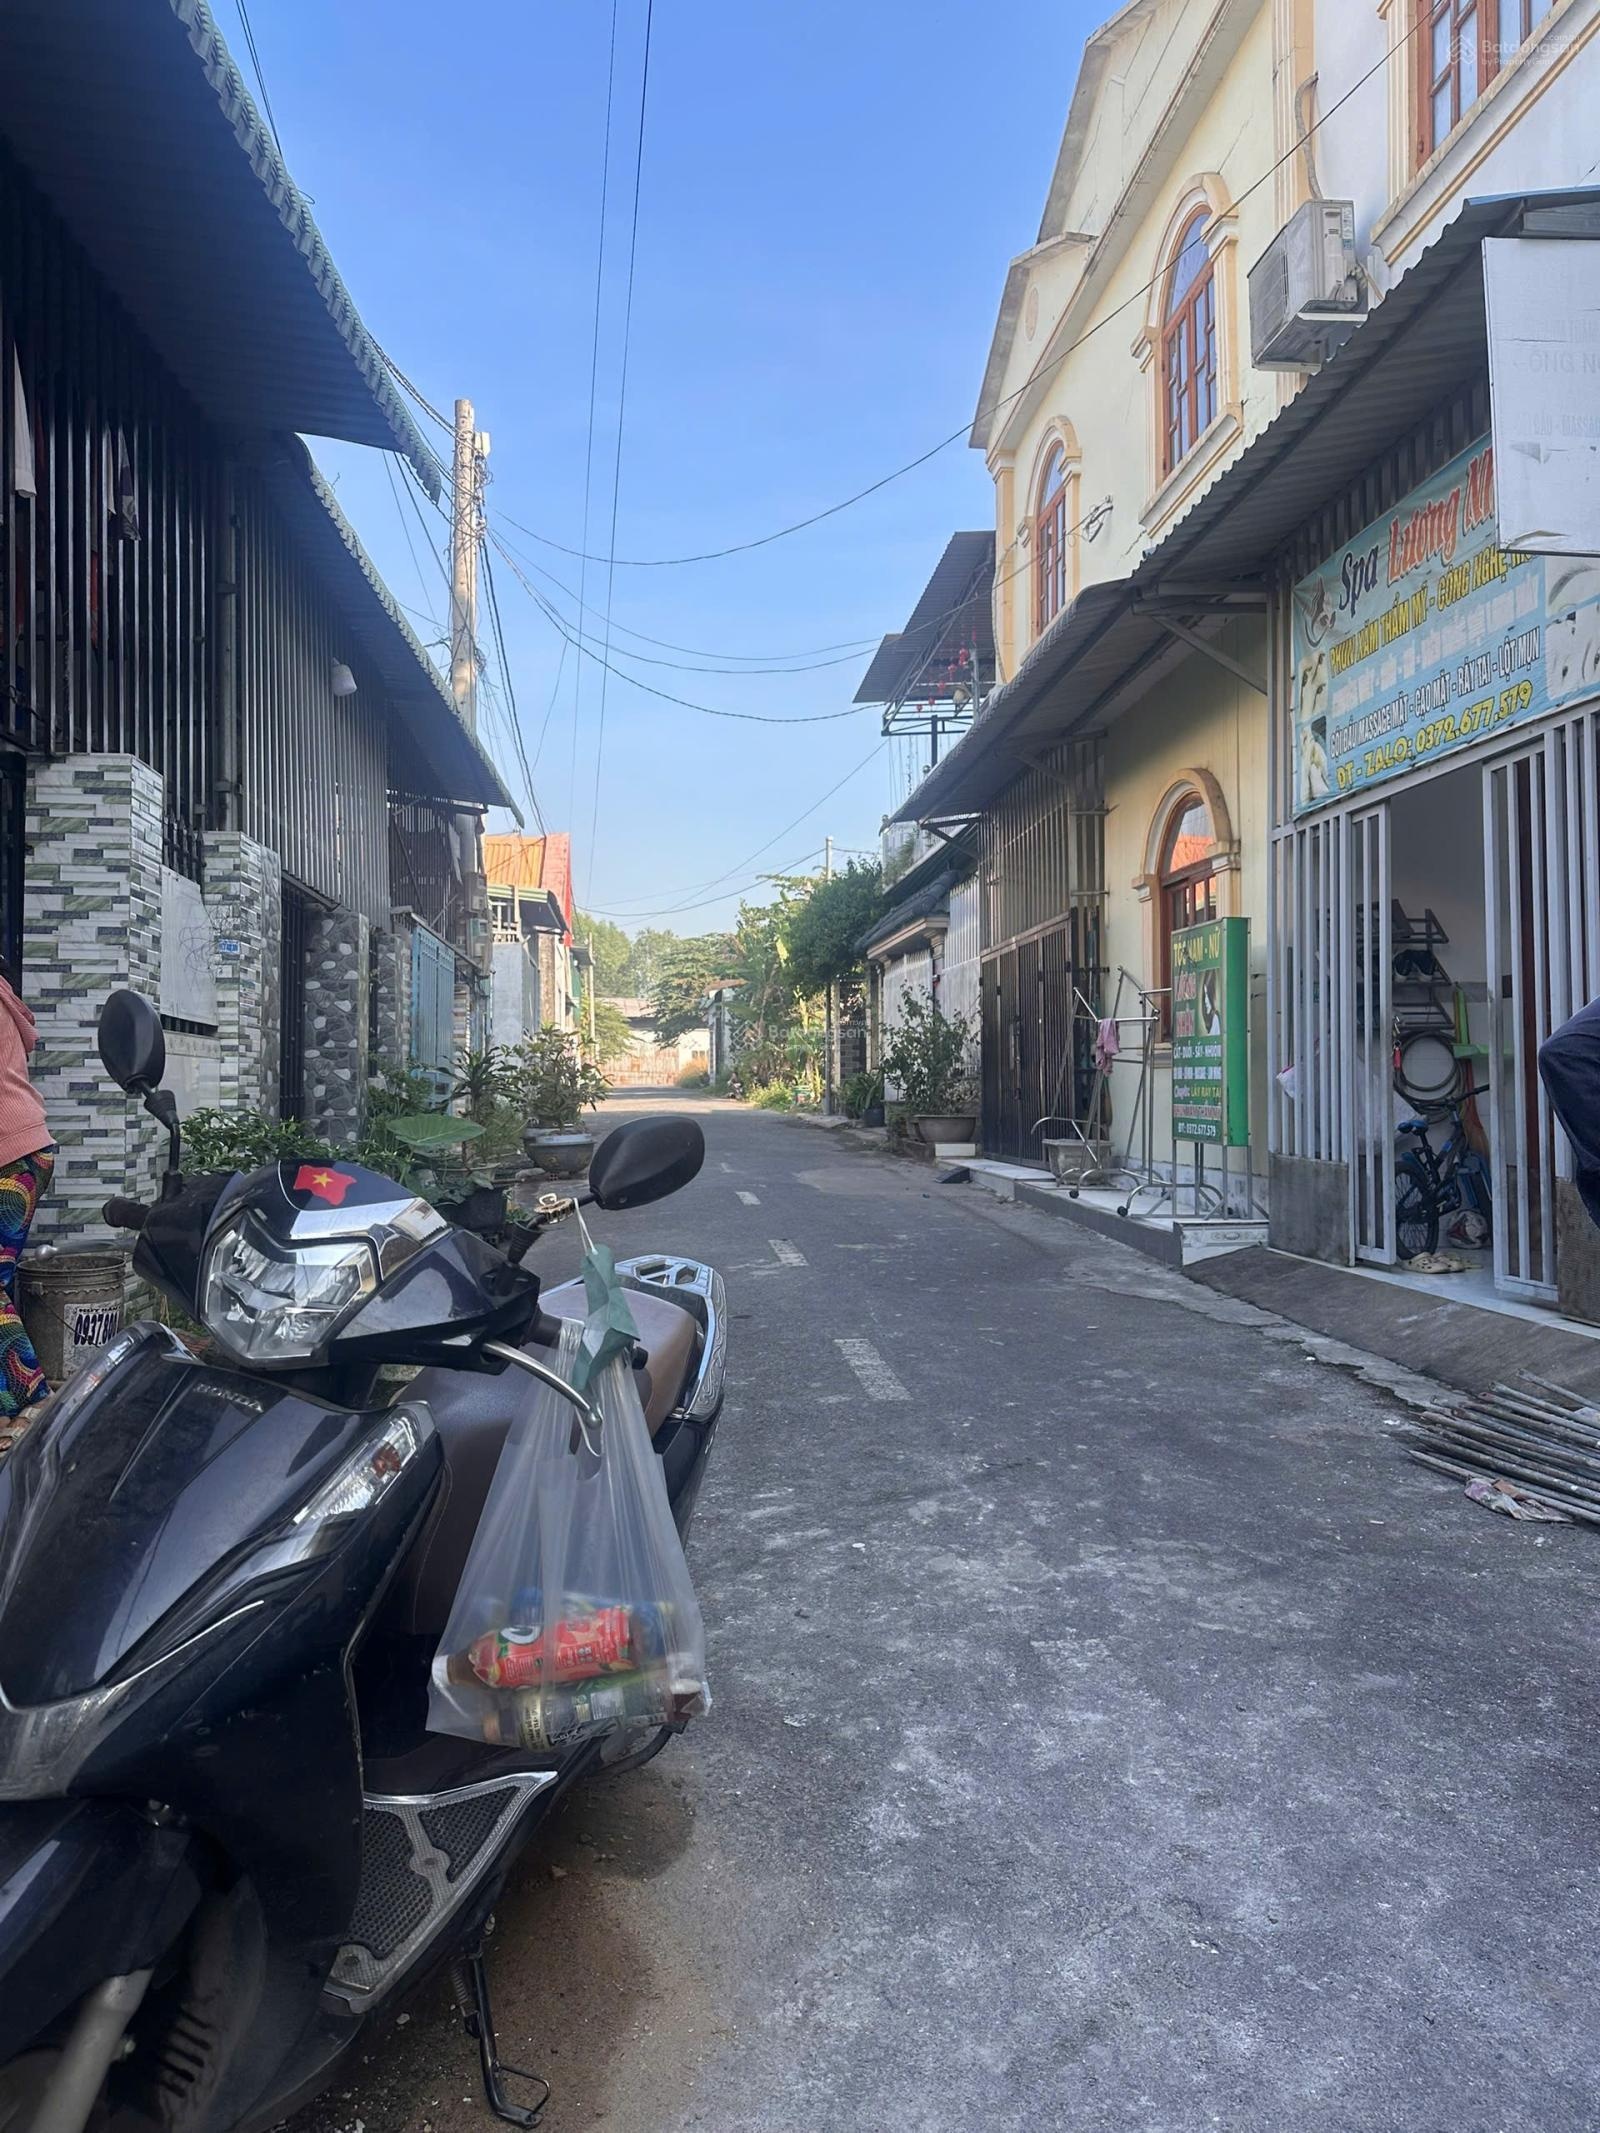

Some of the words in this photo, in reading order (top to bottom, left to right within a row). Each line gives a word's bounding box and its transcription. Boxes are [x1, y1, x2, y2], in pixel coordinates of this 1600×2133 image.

[1330, 637, 1356, 678] PHUN
[1356, 618, 1379, 663] XĂM
[1380, 592, 1409, 647] THẨM
[1438, 560, 1471, 612] CÔNG
[1339, 546, 1379, 618] Spa
[1358, 704, 1391, 745] MASSAGE
[1477, 652, 1492, 688] TAI
[1364, 736, 1414, 779] ZALO:
[1415, 679, 1534, 753] 0372.677.579
